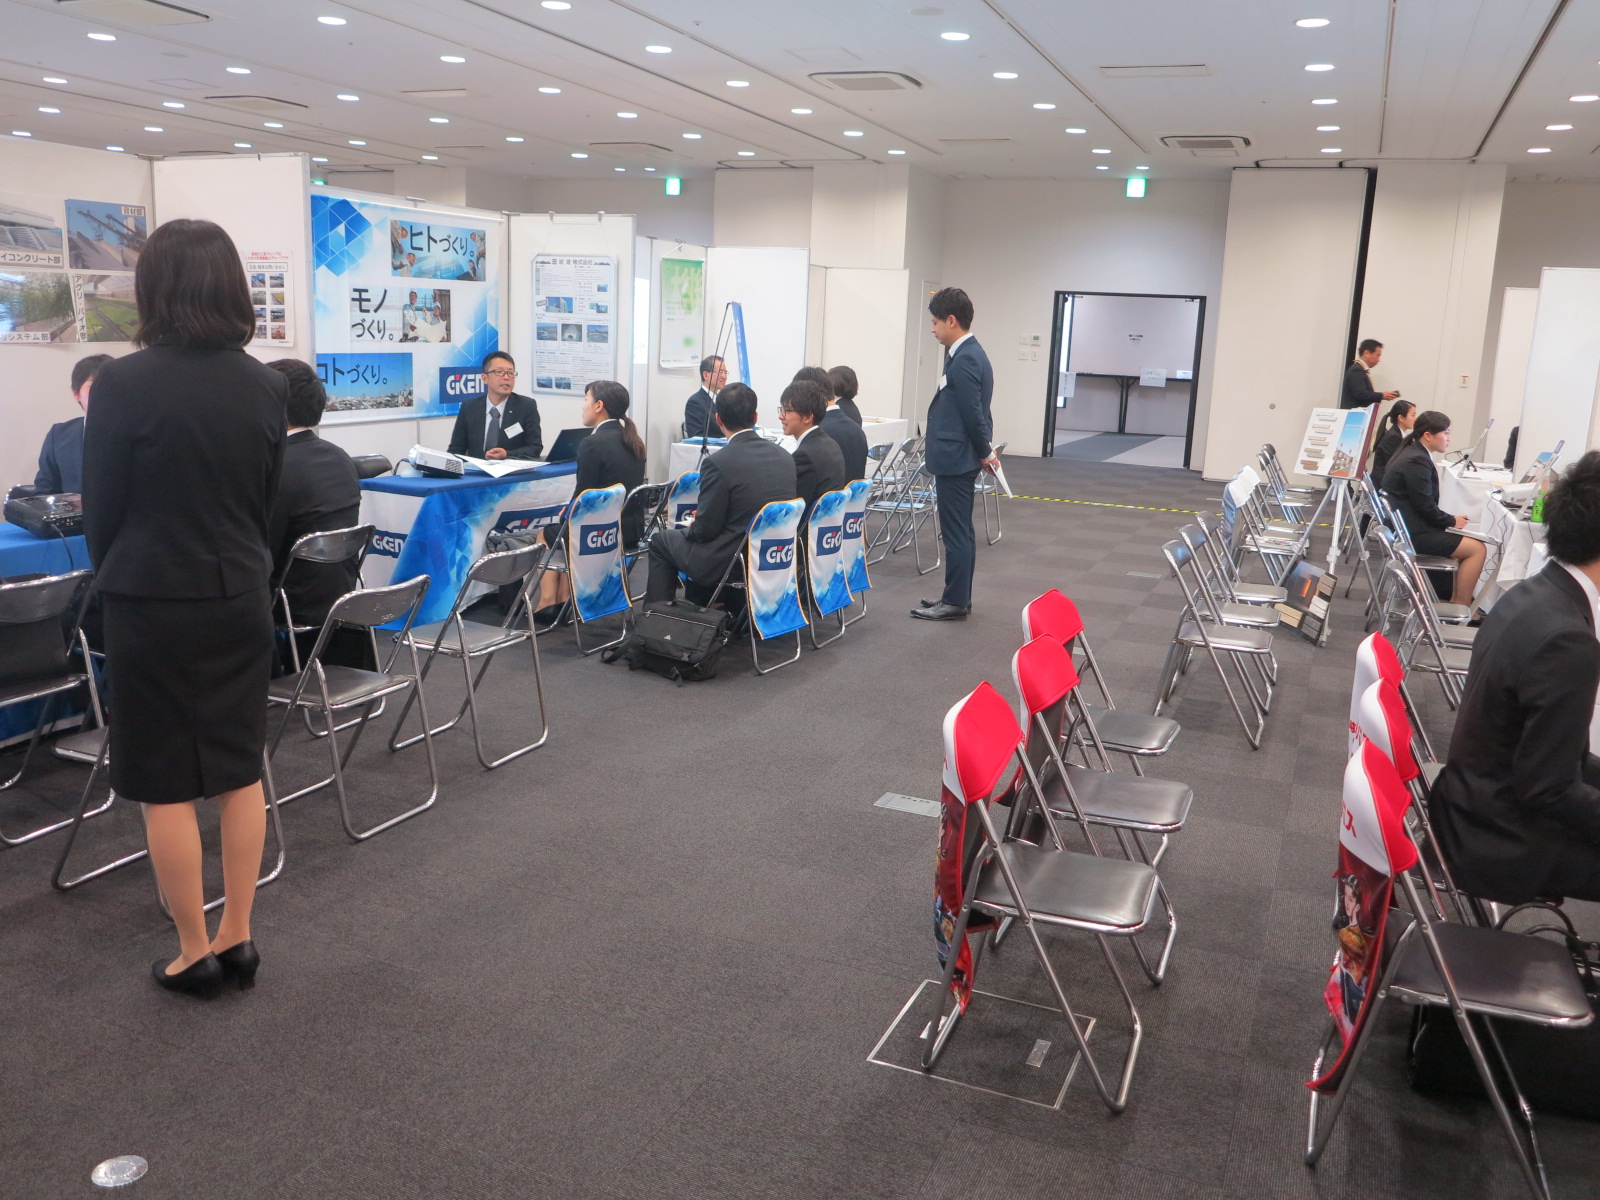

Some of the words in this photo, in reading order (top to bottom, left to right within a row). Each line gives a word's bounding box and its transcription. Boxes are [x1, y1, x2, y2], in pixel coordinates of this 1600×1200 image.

[409, 225, 474, 257] ヒトづくり。
[0, 252, 61, 264] イコンクリート部
[75, 275, 87, 340] アグリ・バイオ部
[351, 287, 388, 314] モノ
[351, 318, 394, 341] づくり。
[316, 357, 387, 386] コトづくり。
